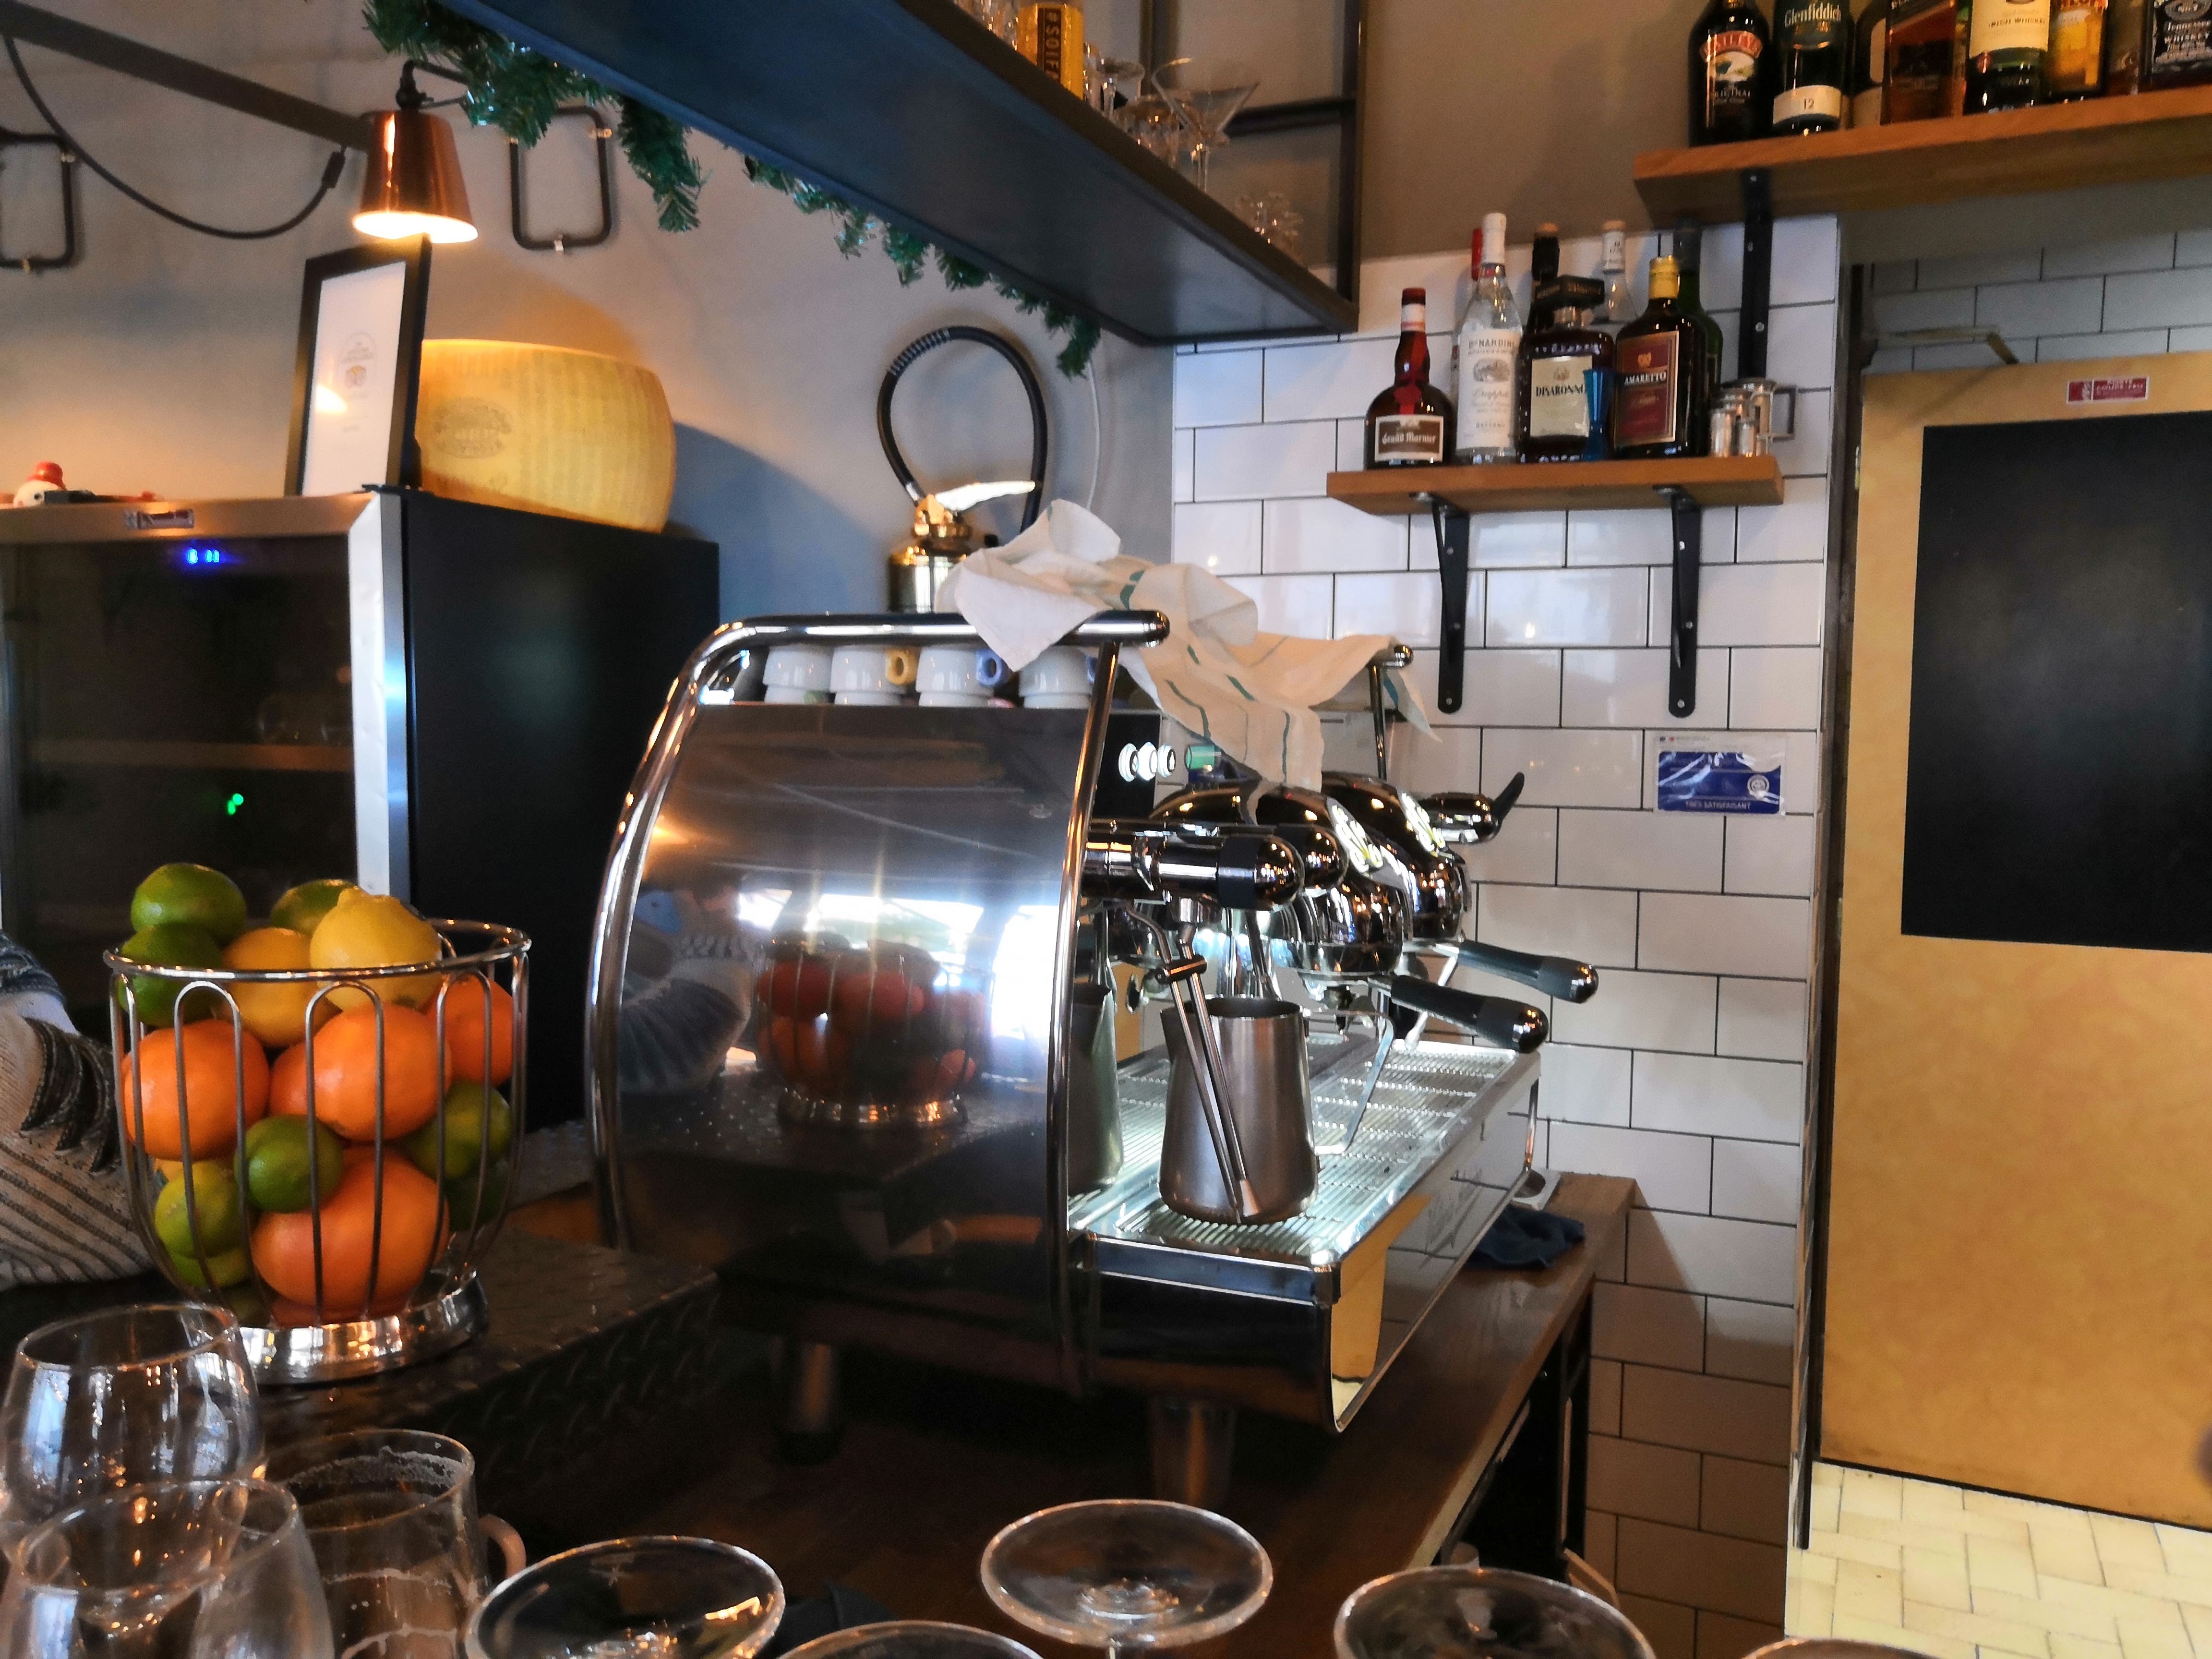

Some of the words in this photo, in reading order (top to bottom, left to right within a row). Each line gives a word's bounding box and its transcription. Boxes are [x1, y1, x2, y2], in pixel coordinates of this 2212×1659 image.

[1784, 3, 1841, 27] Glenfiddich
[1803, 97, 1815, 110] 12
[1624, 371, 1667, 387] AMARETTO
[1536, 384, 1587, 397] DISARONNO
[1382, 433, 1405, 445] Grand
[1406, 432, 1437, 444] Marnier
